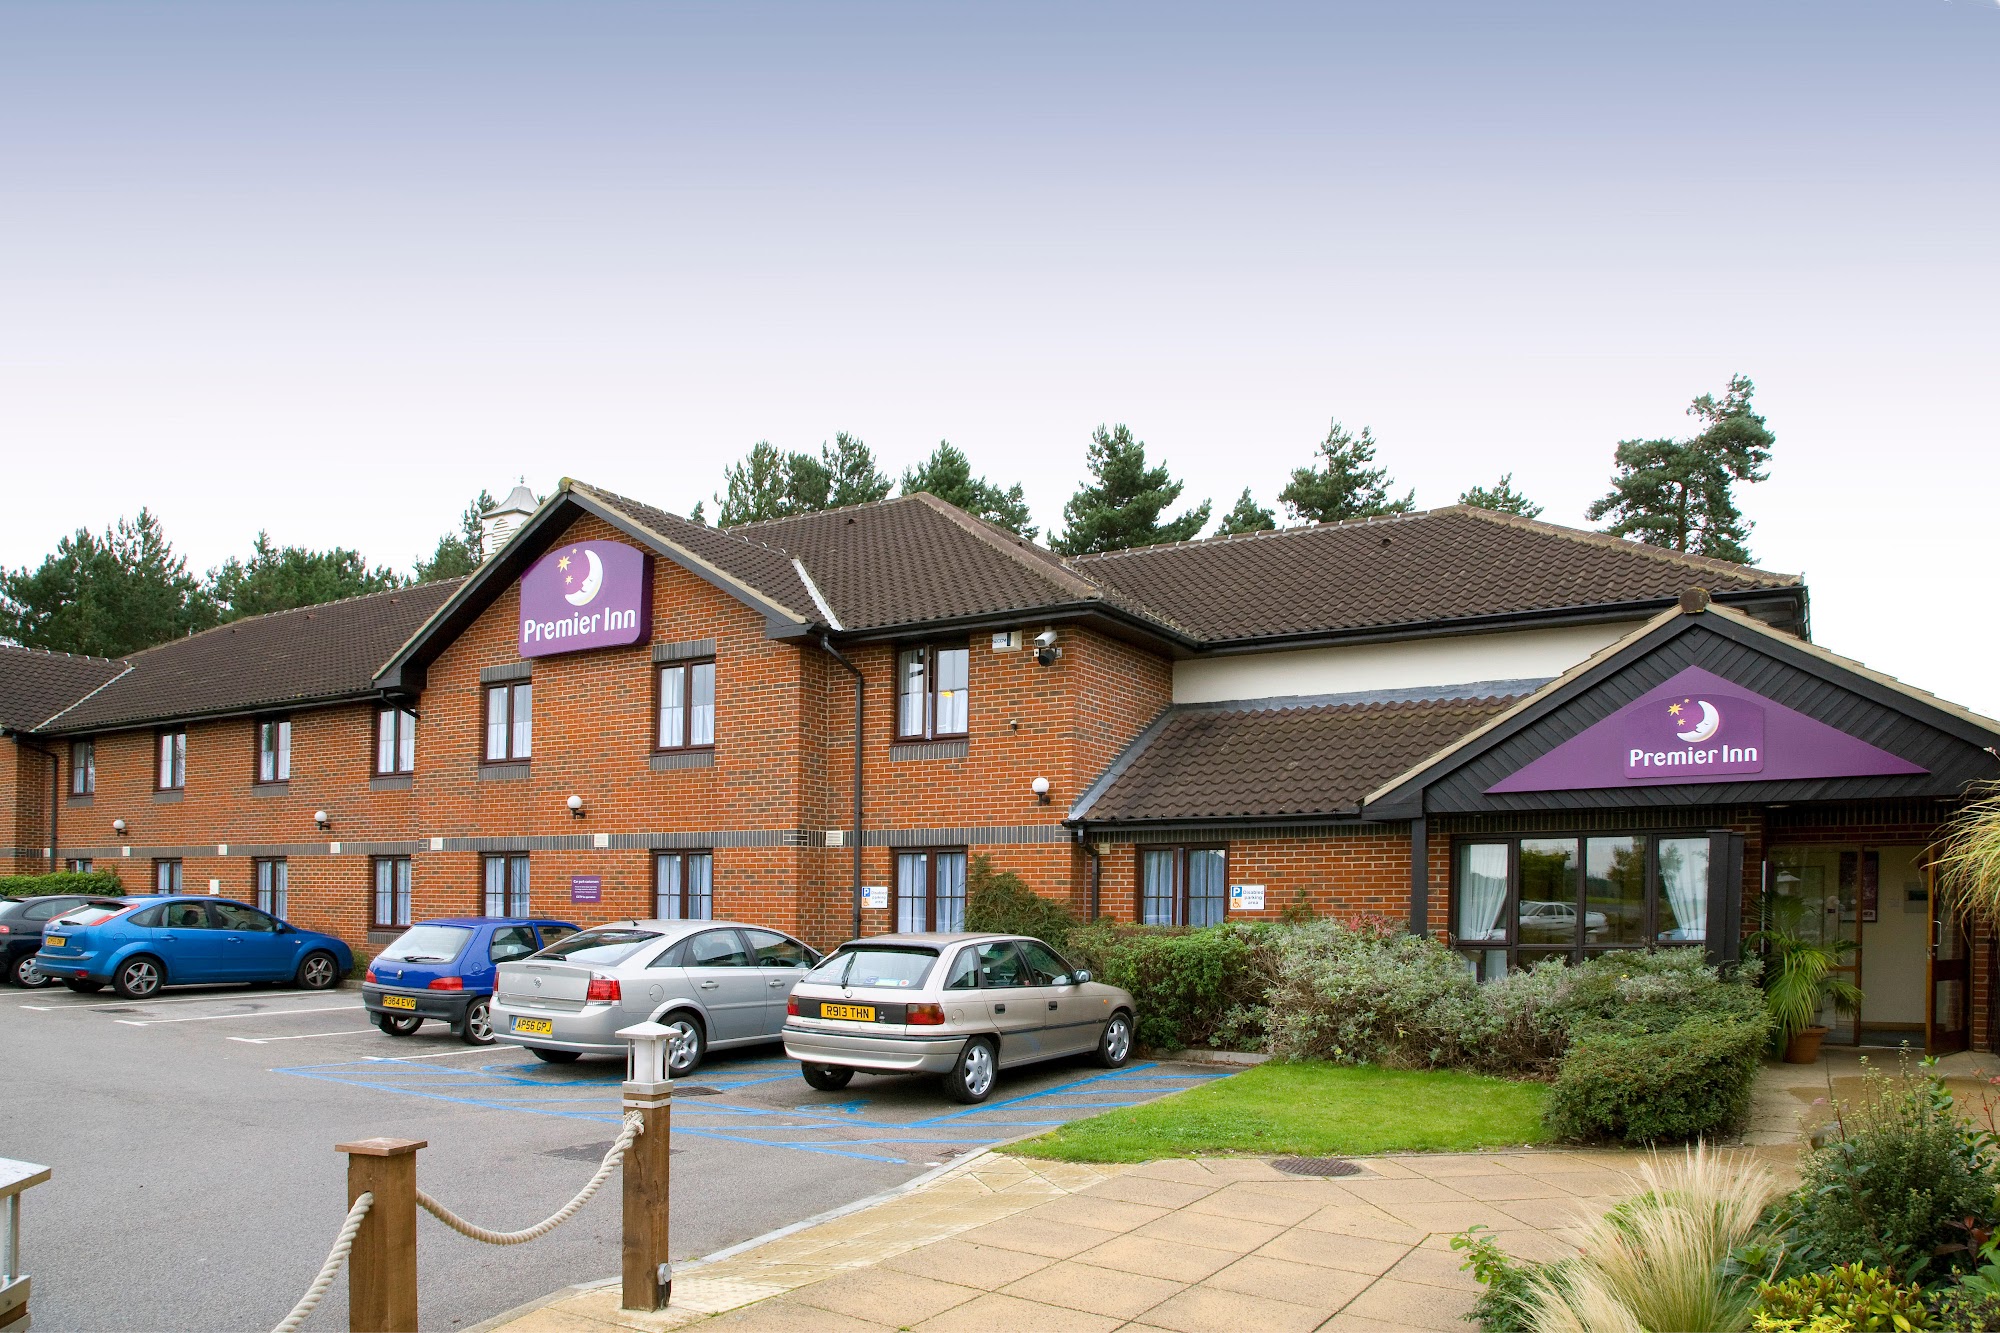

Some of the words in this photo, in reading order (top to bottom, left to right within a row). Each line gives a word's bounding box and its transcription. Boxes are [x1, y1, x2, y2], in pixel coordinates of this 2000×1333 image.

[524, 611, 600, 643] Premier
[604, 607, 636, 631] Inn
[1630, 746, 1718, 767] Premier
[1722, 744, 1757, 763] Inn
[863, 888, 870, 897] P
[1233, 887, 1241, 897] P
[383, 996, 400, 1006] R364
[826, 1005, 847, 1017] R913
[850, 1007, 869, 1019] THN
[516, 1018, 535, 1031] AP56
[536, 1020, 552, 1033] GPJ
